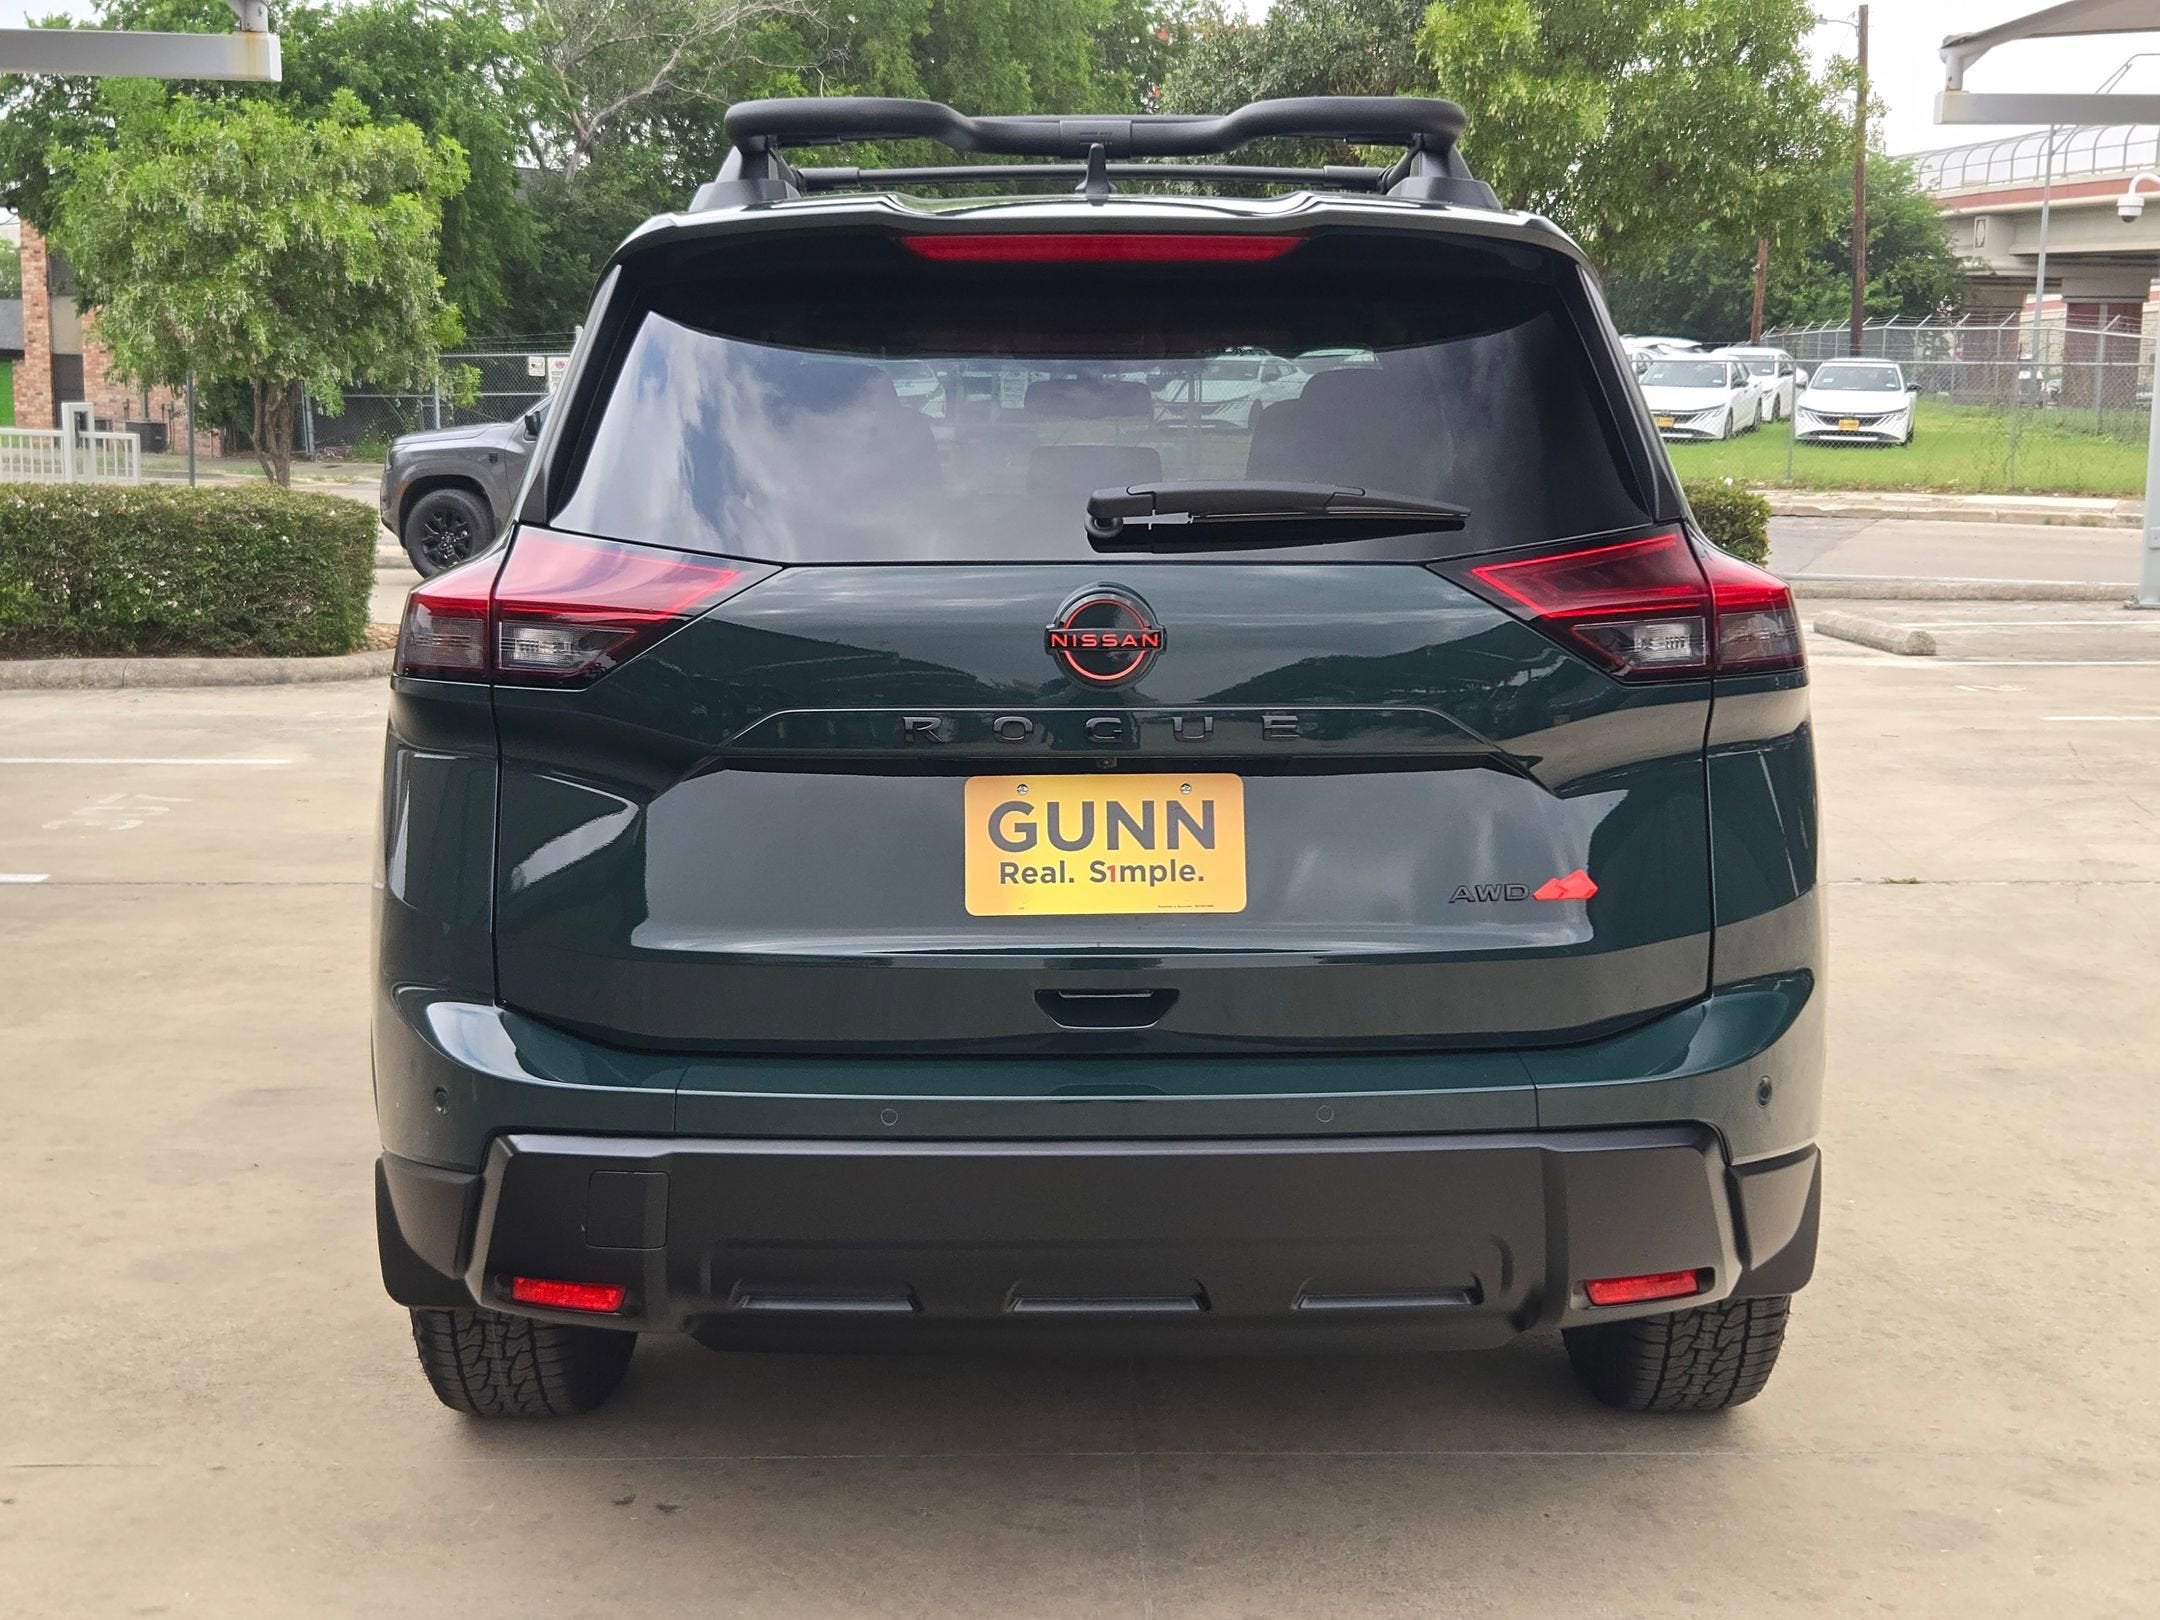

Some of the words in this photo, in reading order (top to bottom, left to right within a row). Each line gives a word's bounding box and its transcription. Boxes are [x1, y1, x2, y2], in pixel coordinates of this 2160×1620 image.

[1051, 632, 1160, 648] NISSAN
[903, 715, 1300, 744] ROGUE
[988, 800, 1215, 853] GUNN
[1000, 860, 1075, 884] Real.
[1449, 884, 1529, 903] AWD
